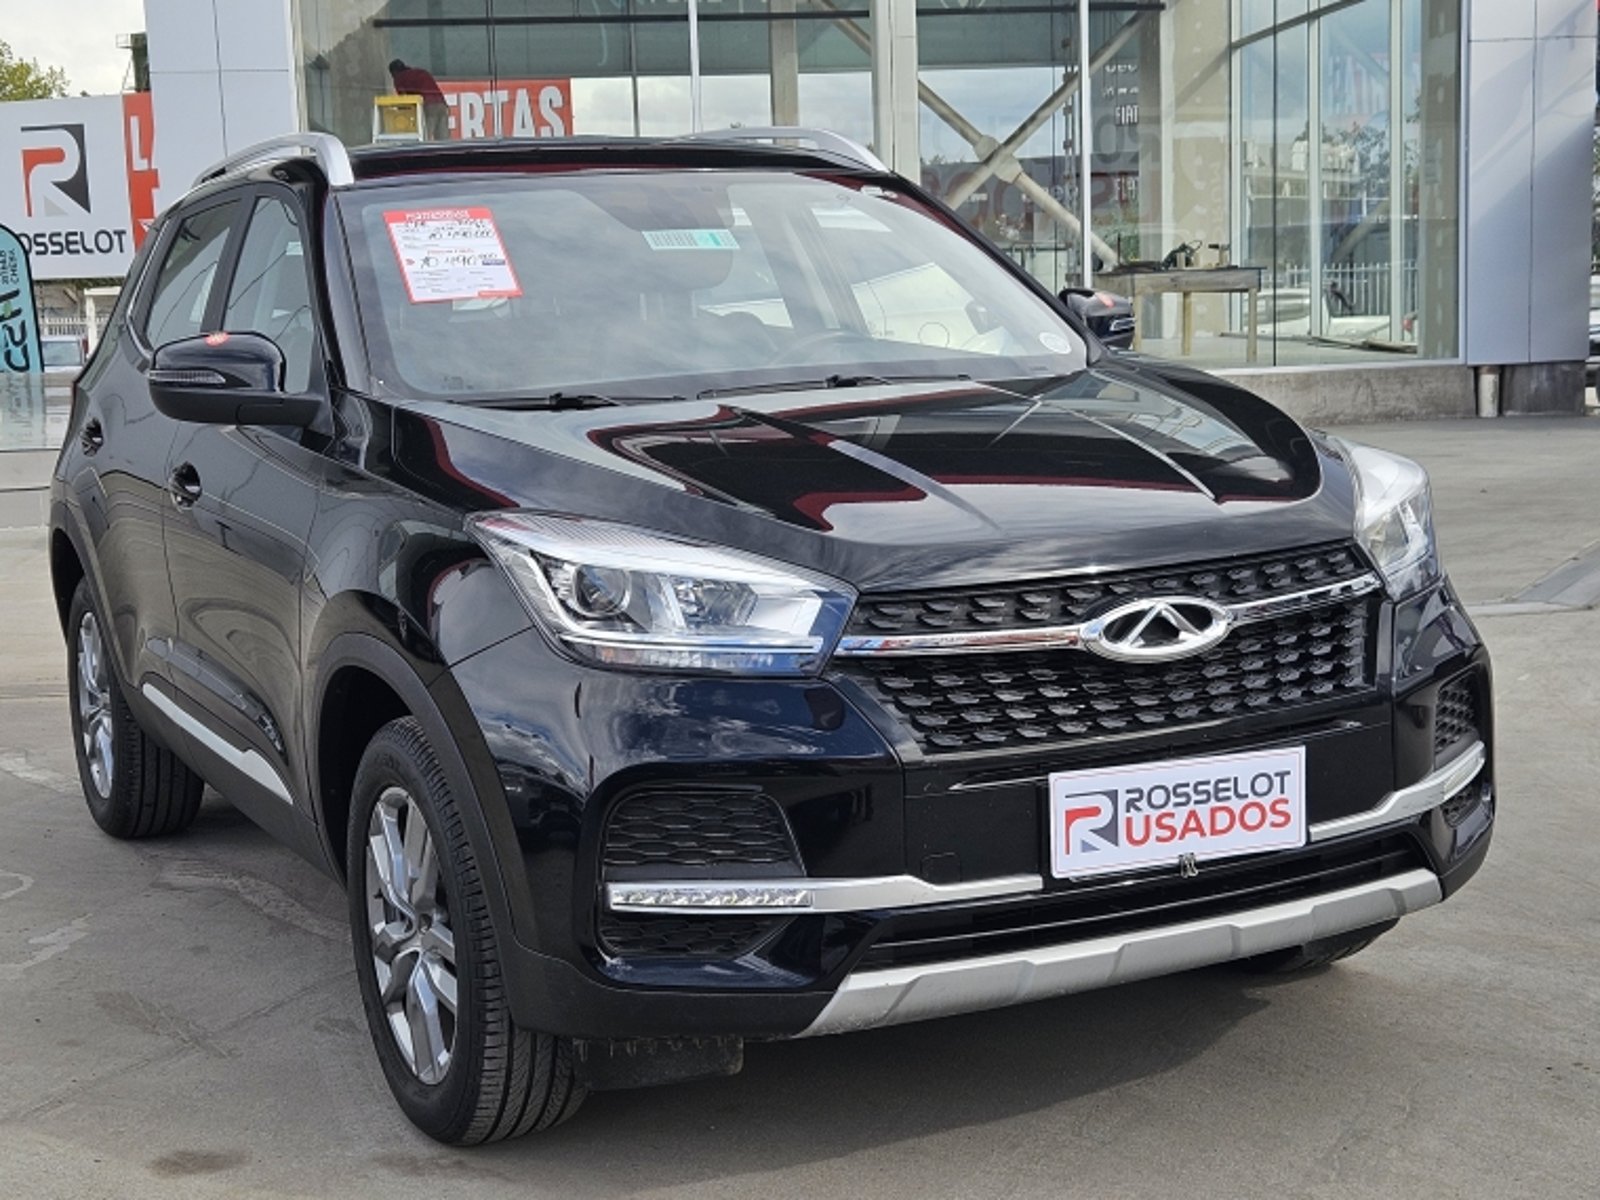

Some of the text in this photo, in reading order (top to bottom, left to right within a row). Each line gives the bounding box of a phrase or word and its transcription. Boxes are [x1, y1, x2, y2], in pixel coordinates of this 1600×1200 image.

[1114, 104, 1139, 125] FIAT
[17, 229, 127, 256] OSSELOT
[1125, 770, 1292, 813] ROSSELOT
[1124, 797, 1292, 847] USADOS
